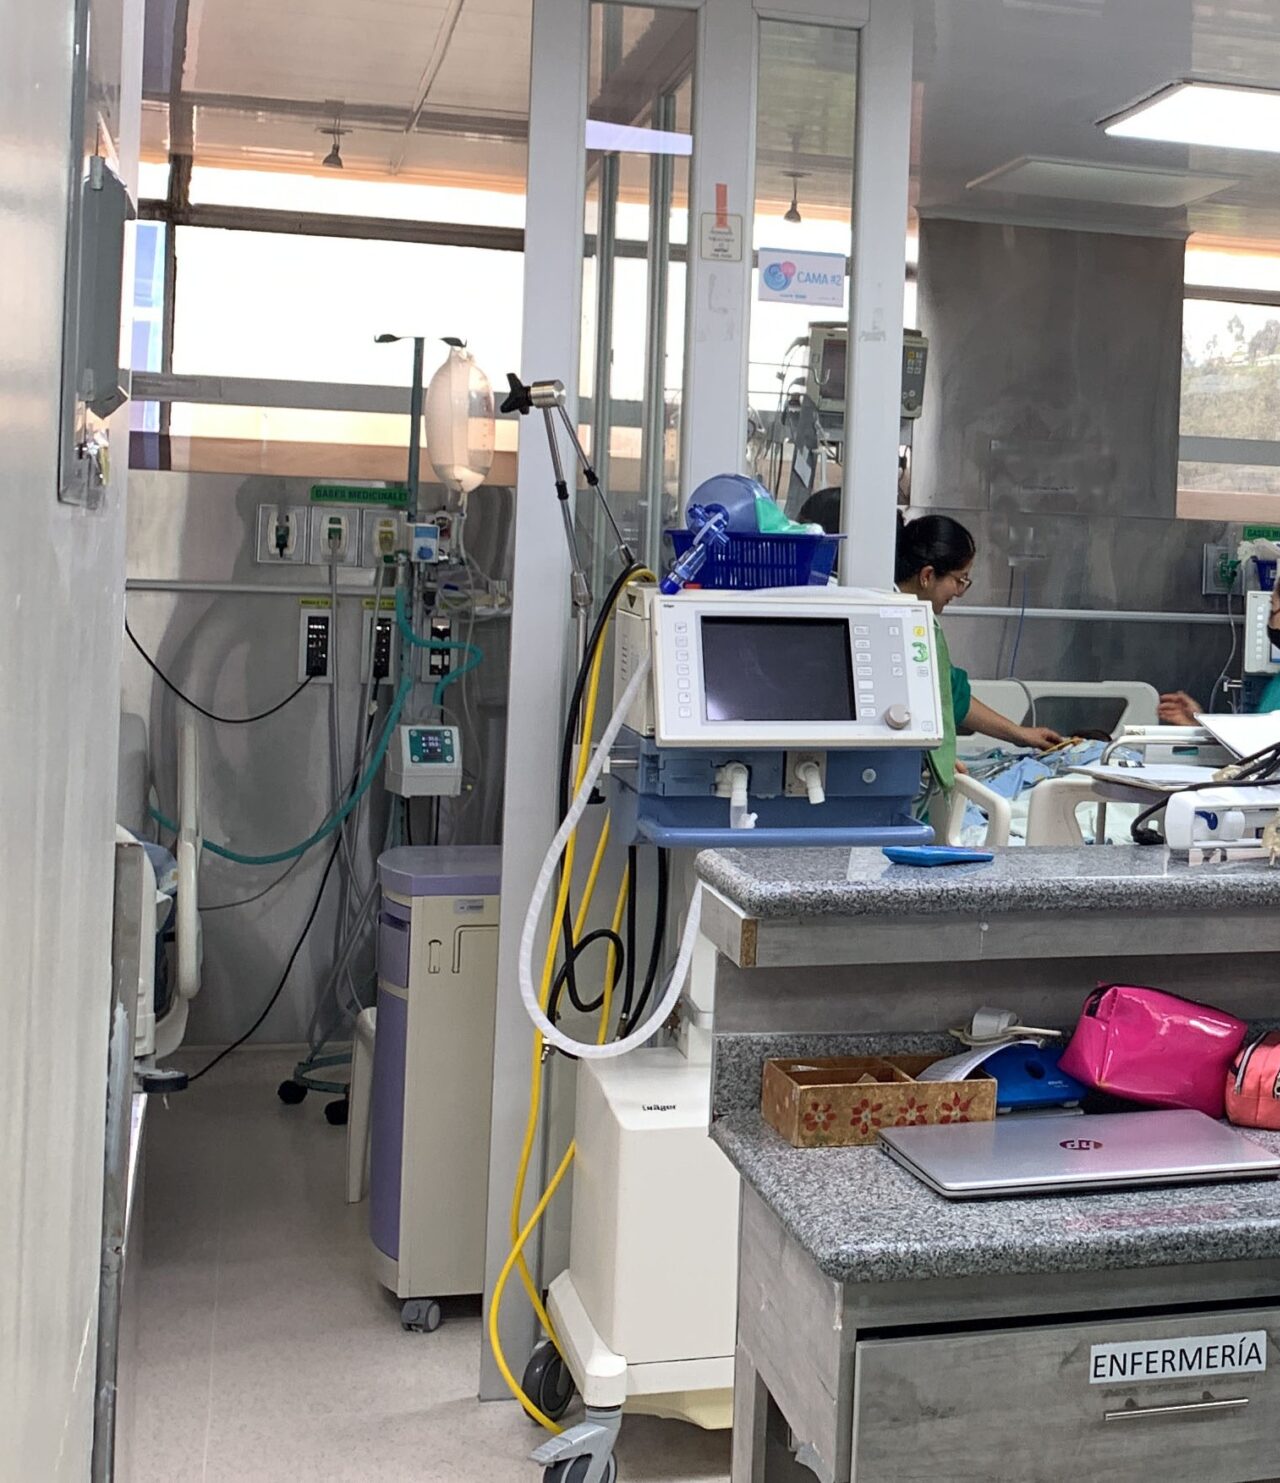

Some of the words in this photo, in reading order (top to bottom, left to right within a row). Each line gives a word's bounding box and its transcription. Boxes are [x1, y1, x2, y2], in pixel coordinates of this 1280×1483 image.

[797, 271, 829, 286] CAMA
[830, 274, 842, 286] #2
[911, 641, 929, 663] 3
[1092, 1336, 1262, 1379] ENFERMERÍA
